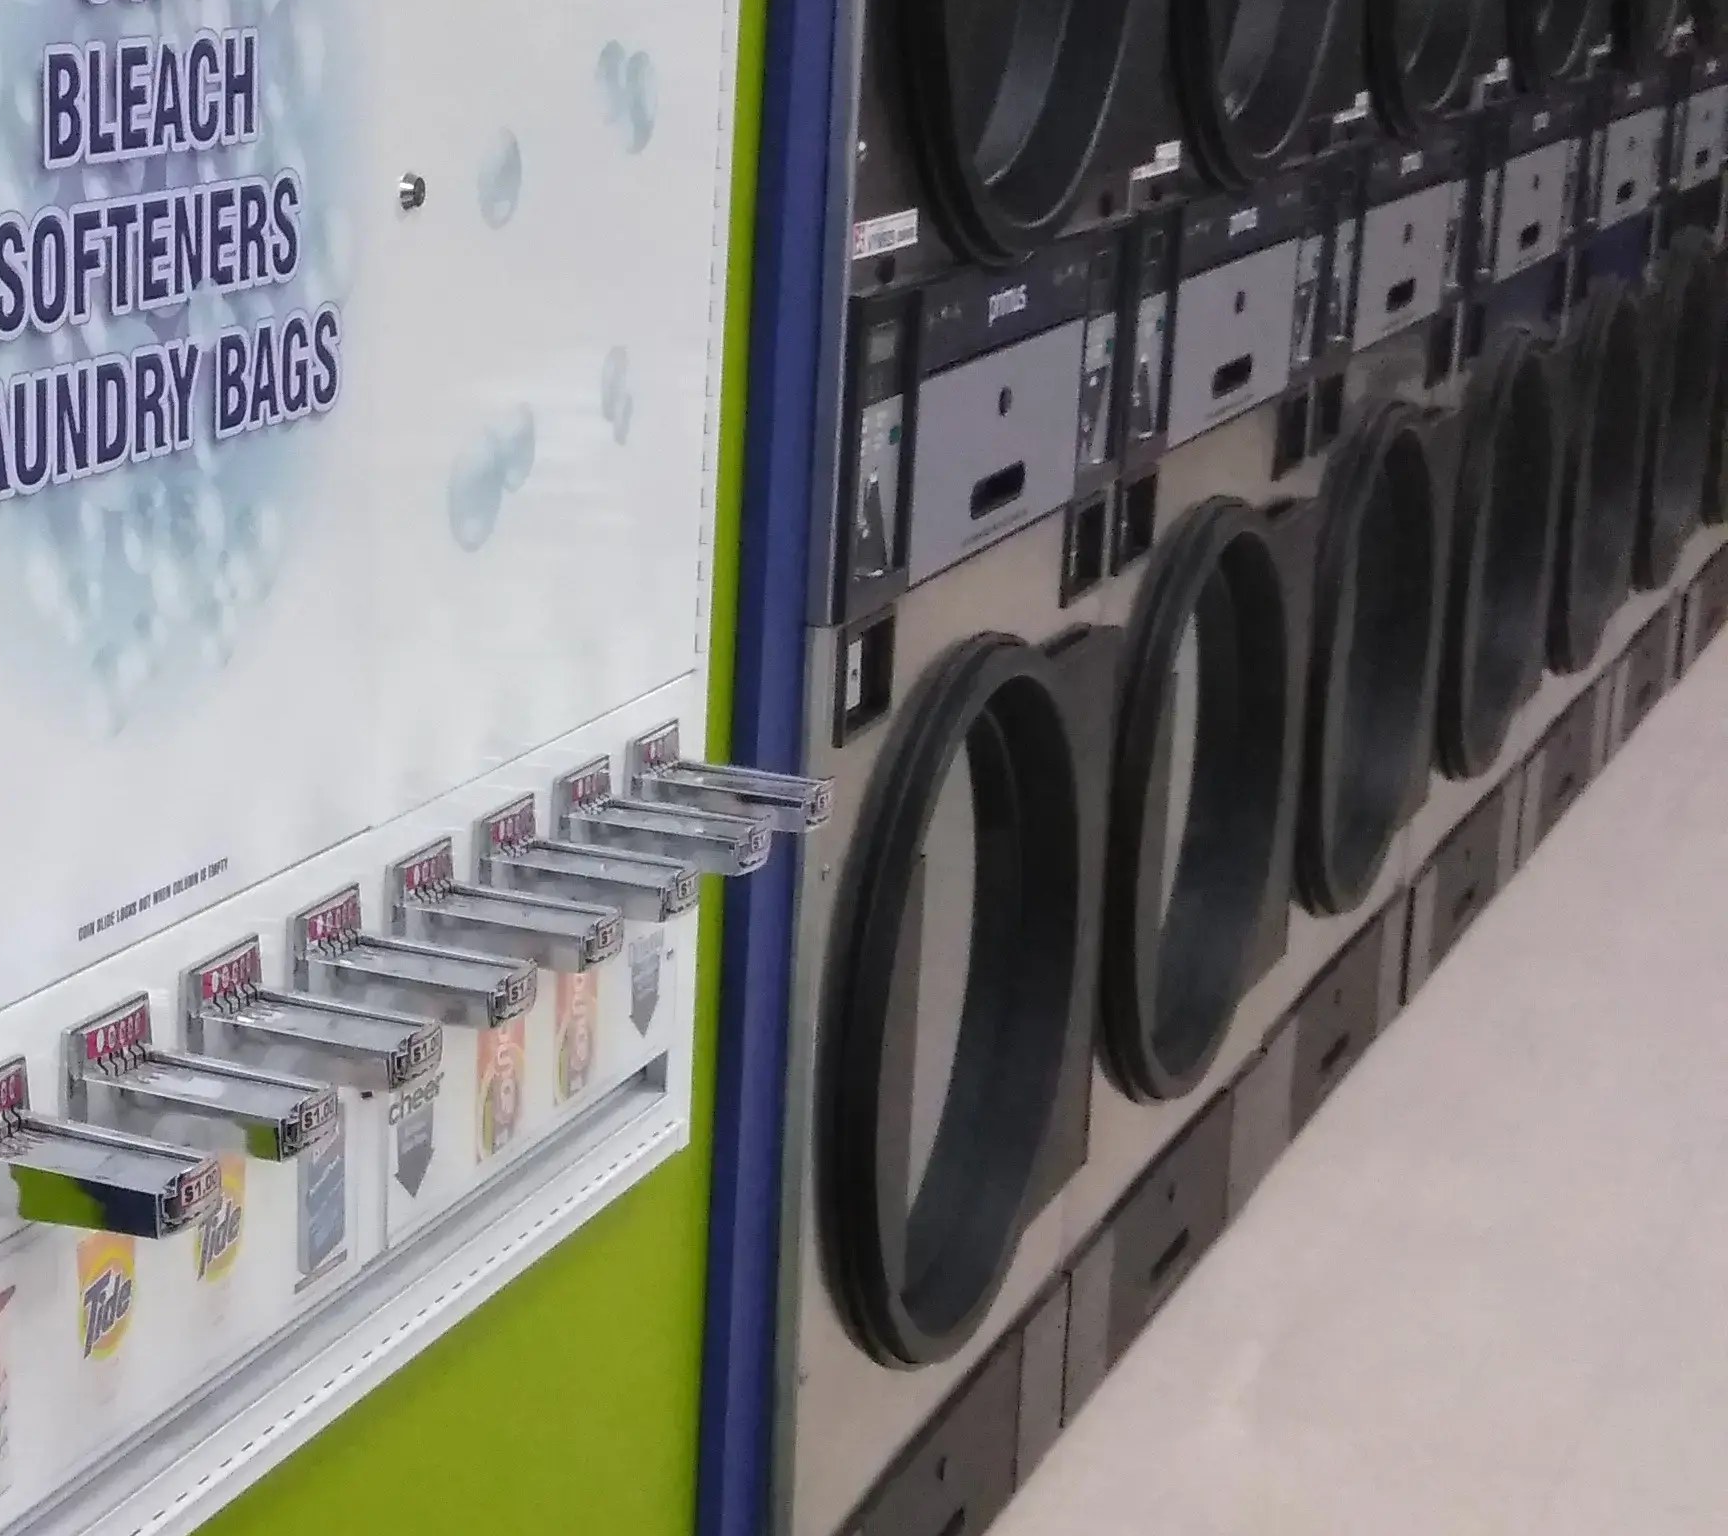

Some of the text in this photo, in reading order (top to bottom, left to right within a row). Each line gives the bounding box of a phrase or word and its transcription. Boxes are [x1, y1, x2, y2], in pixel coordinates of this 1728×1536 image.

[42, 28, 258, 169] BLEACH
[214, 301, 342, 438] BAGS
[197, 1199, 242, 1282] Tide
[83, 1268, 133, 1360] Tide
